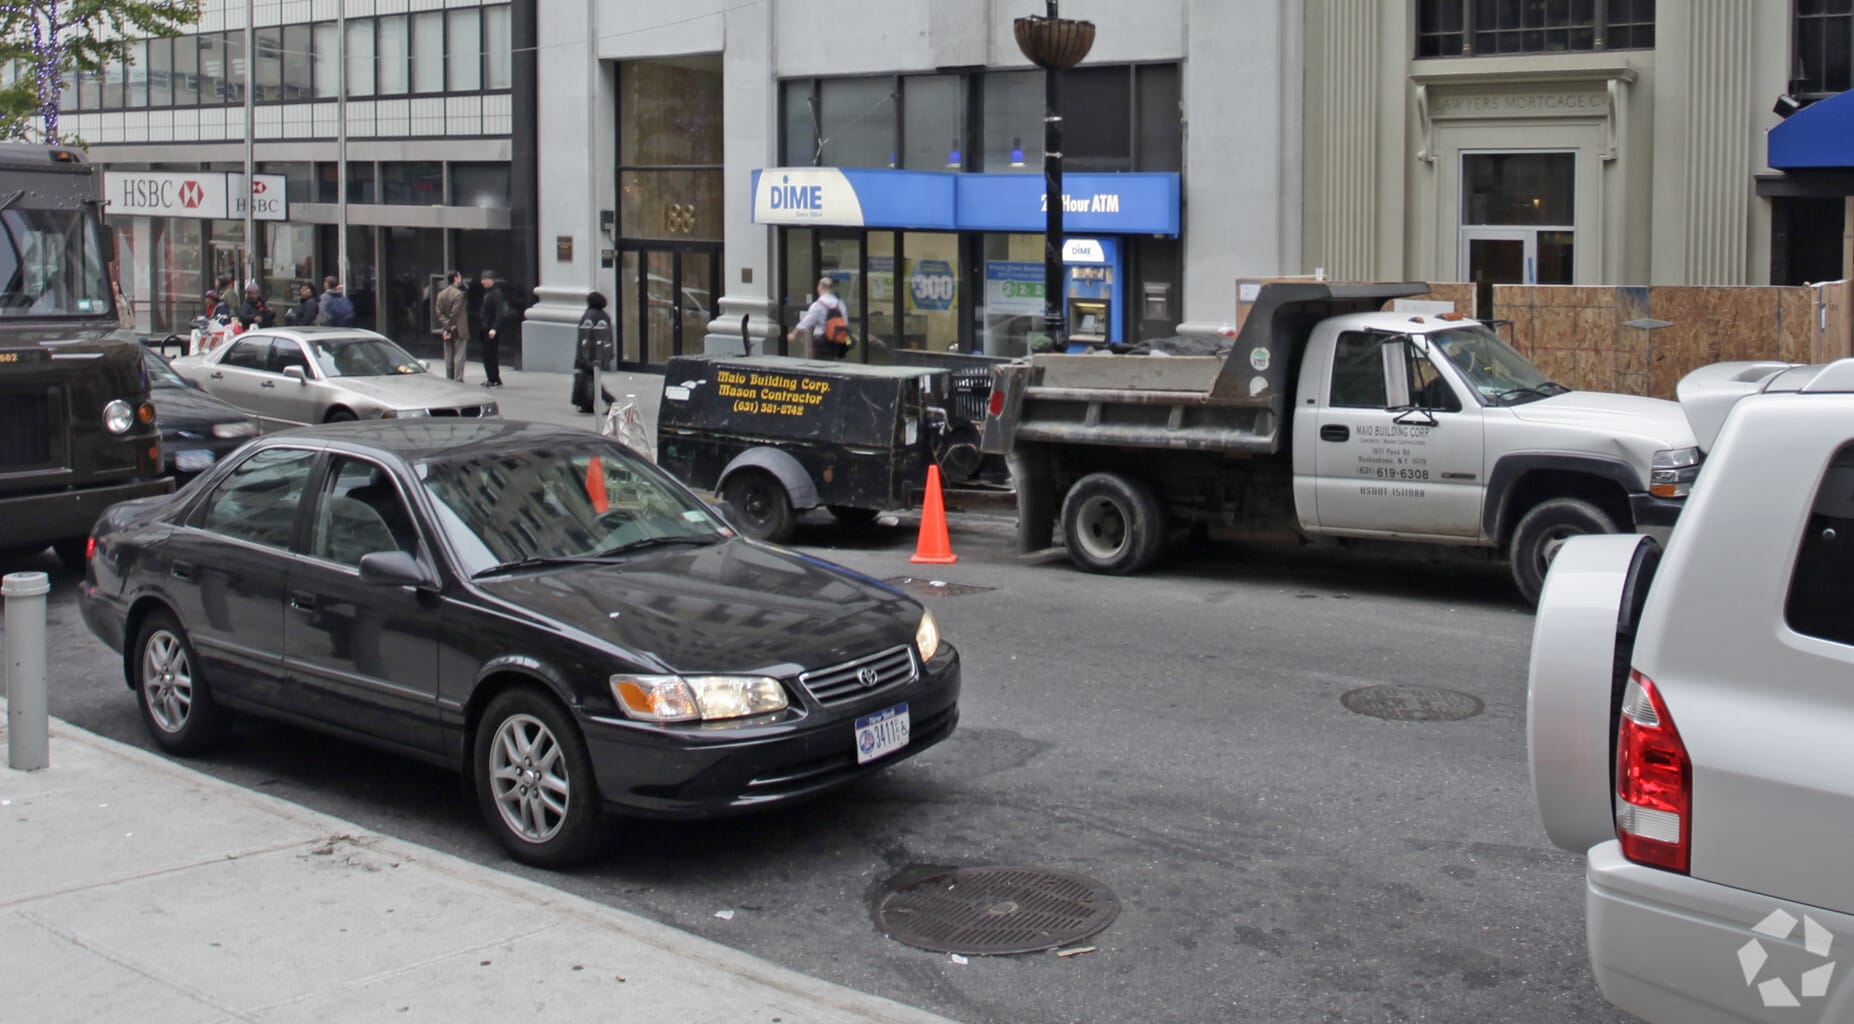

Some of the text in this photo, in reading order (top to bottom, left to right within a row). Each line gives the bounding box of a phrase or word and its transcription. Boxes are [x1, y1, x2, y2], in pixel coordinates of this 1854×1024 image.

[1504, 94, 1585, 110] MORTGAGE
[123, 178, 173, 208] HSBC
[1062, 194, 1090, 212] Hour
[1091, 194, 1120, 213] ATM
[749, 372, 798, 391] Building
[801, 378, 832, 394] Corp.
[718, 384, 823, 405] Mason Contractor
[733, 399, 760, 414] (631)
[1375, 425, 1409, 438] BUILDING
[1376, 466, 1430, 480] 619-6308
[1360, 486, 1388, 497] USDOT
